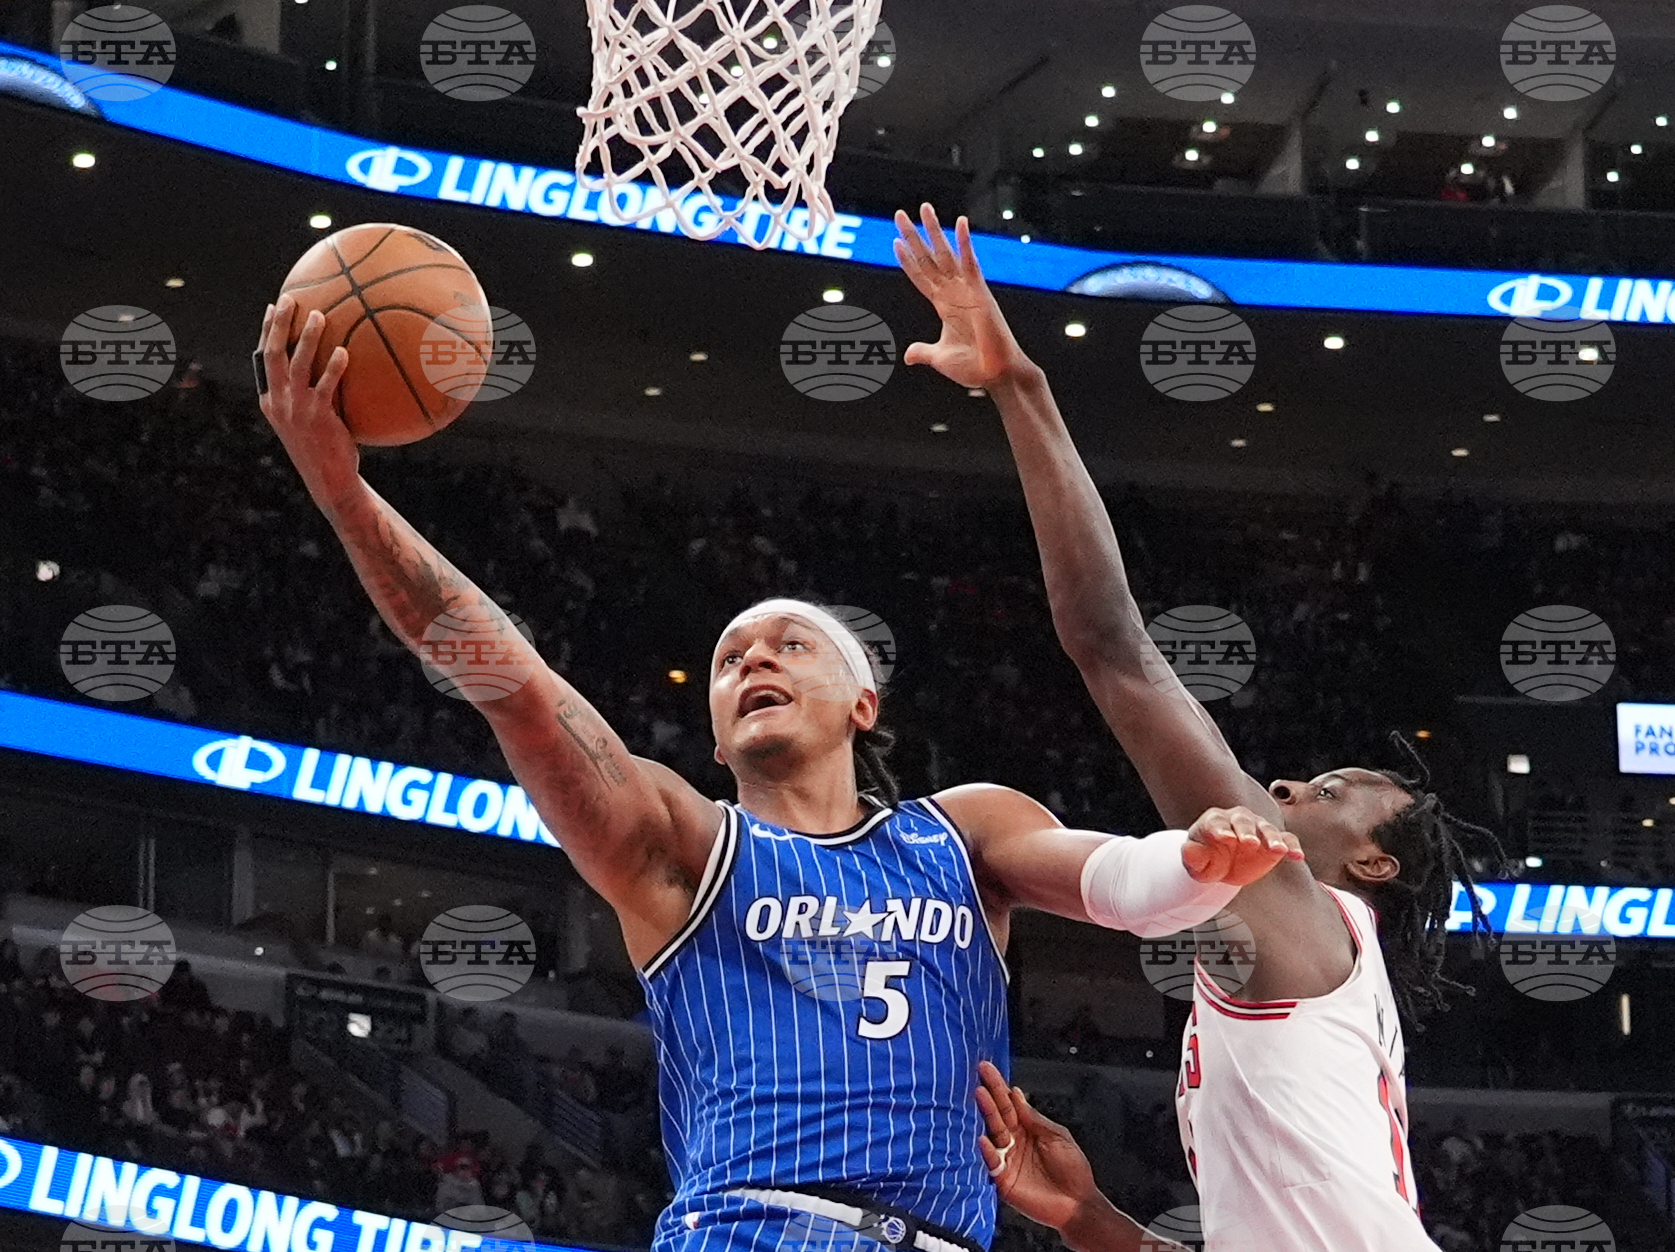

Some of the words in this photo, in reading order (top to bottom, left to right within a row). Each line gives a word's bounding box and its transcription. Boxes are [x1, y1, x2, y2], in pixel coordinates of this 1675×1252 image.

[437, 155, 723, 236] LINGLONG
[732, 198, 863, 260] TIRE
[1579, 276, 1675, 324] LIN
[292, 746, 562, 849] LINGLON
[1504, 883, 1675, 938] LINGL
[856, 960, 912, 1040] 5
